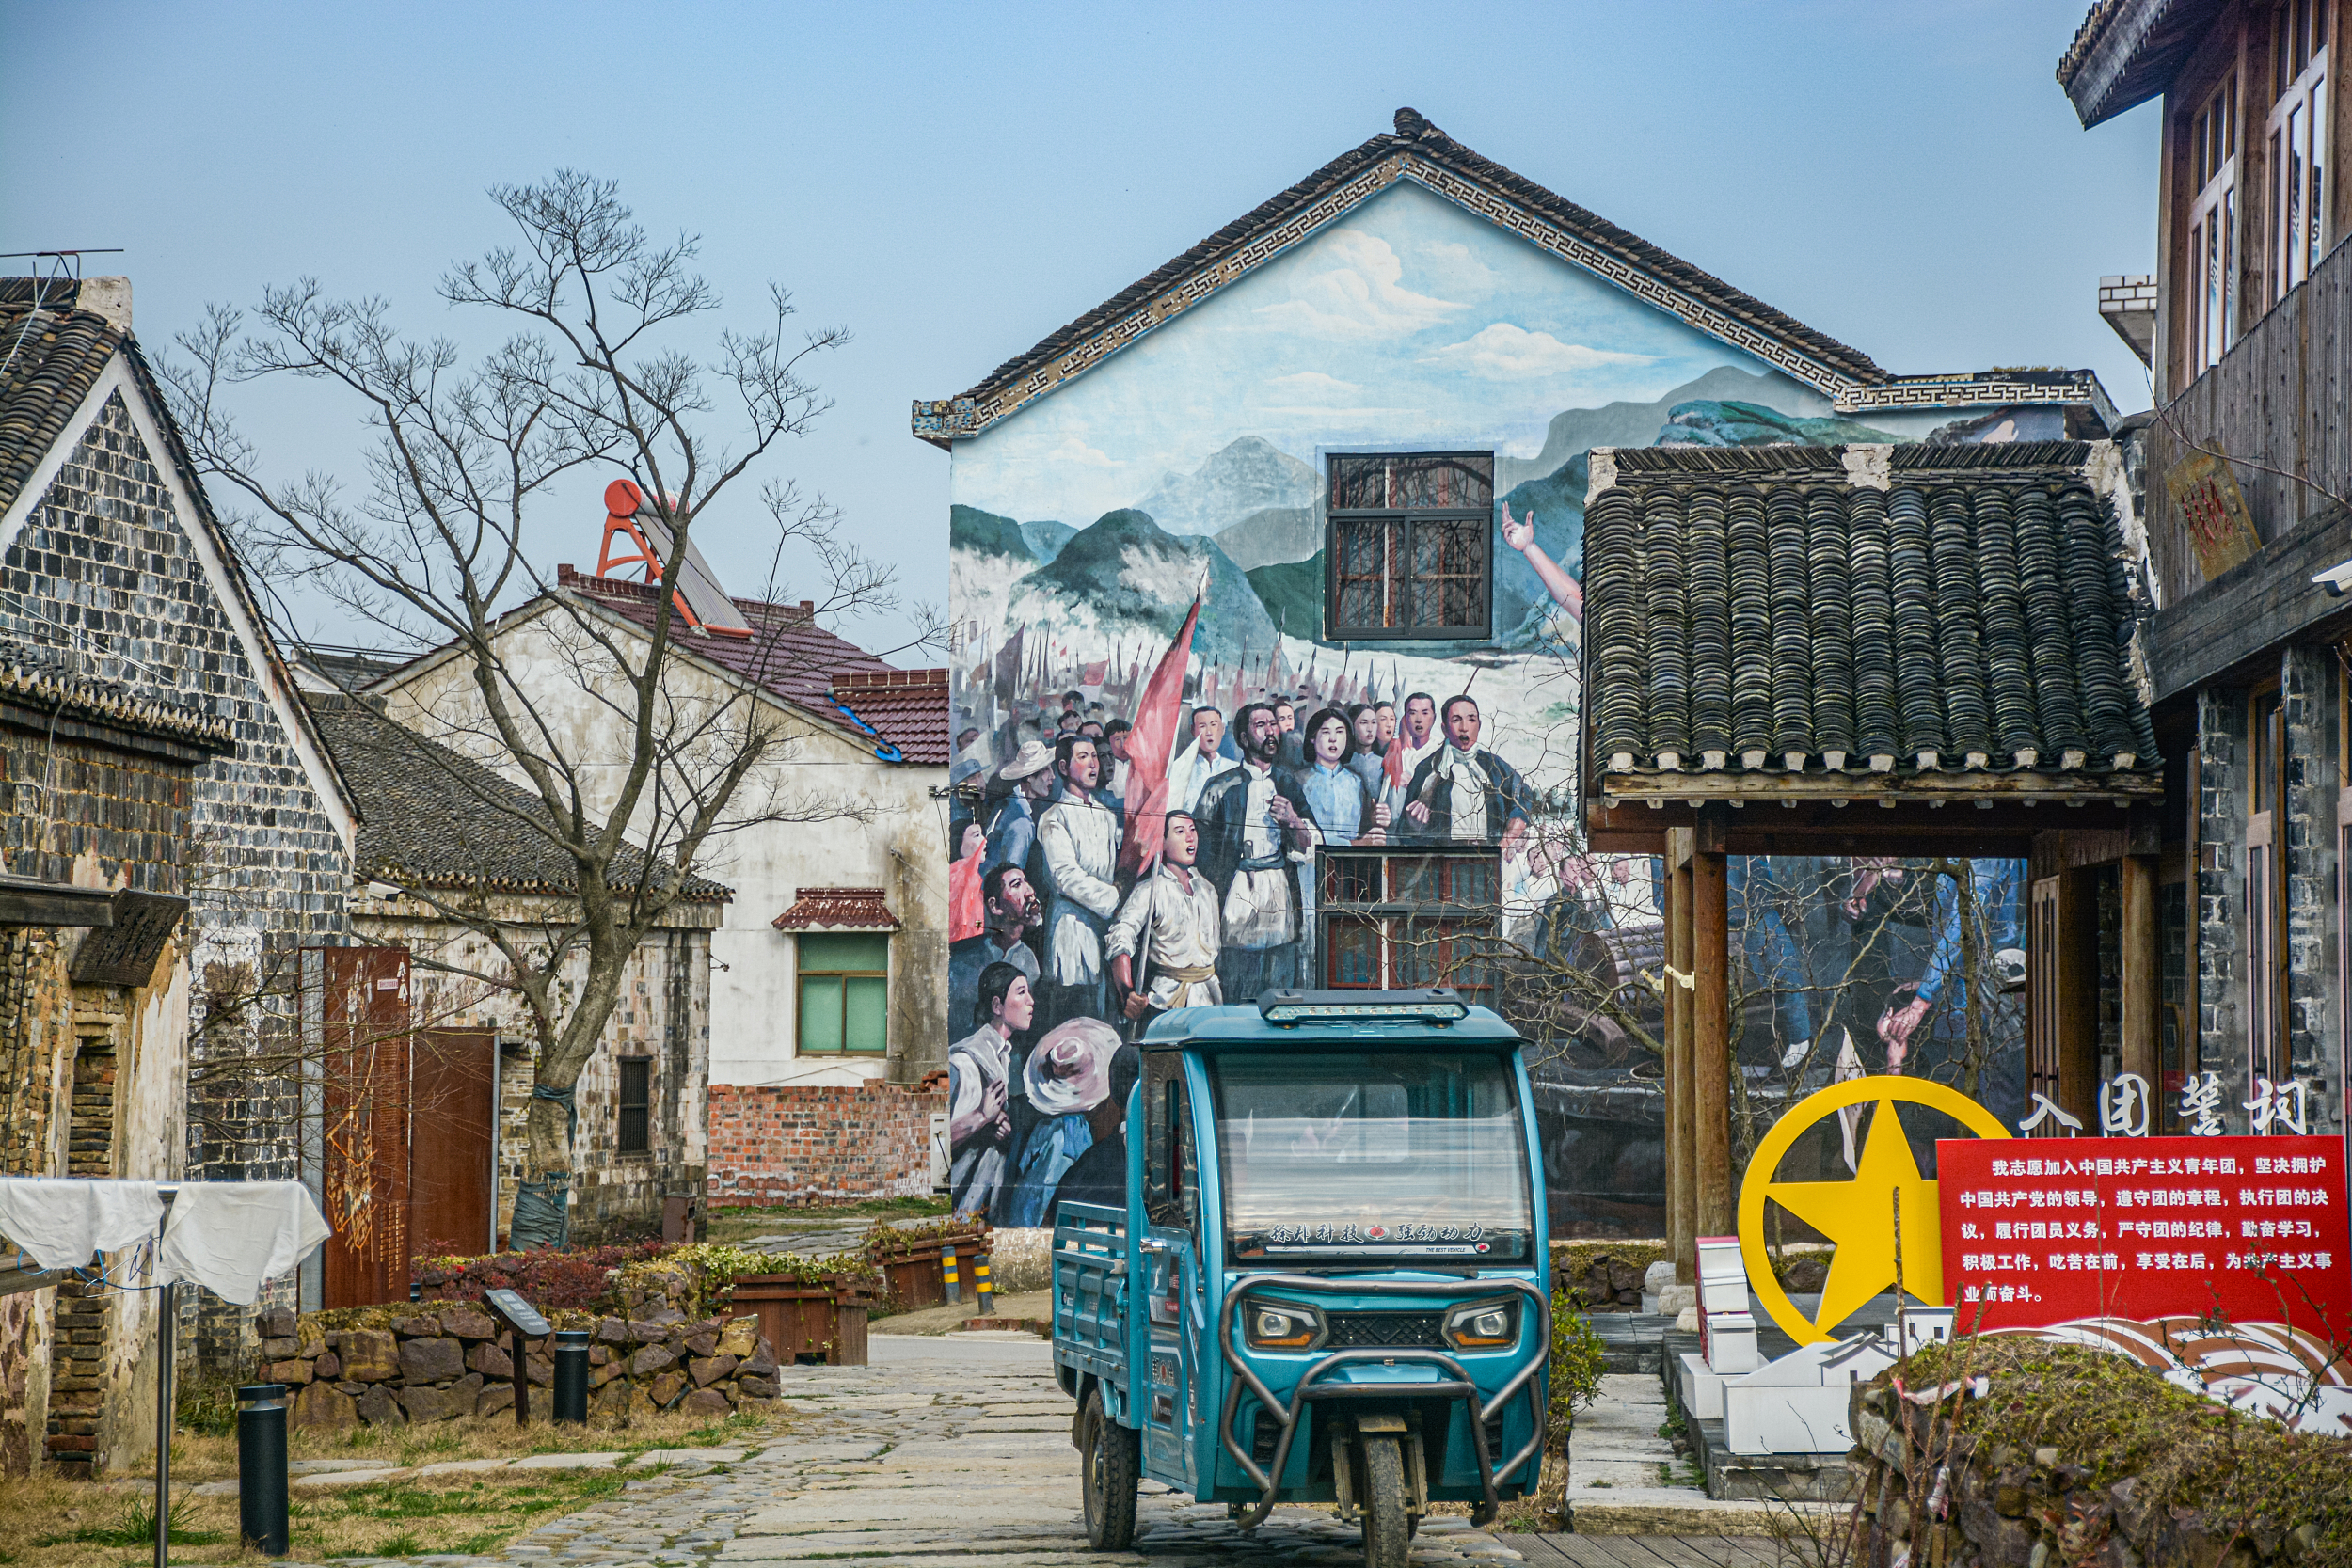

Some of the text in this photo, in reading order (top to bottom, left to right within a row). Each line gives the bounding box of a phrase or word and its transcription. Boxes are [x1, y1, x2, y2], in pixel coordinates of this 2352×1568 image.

[2019, 1073, 2307, 1137] 入团誓词
[1993, 1157, 2326, 1176] 我志愿加入中国共产主义青年团，坚决拥护
[1961, 1189, 2328, 1208] 中国共产党的领导，遵守团的章程，执行团的决
[1394, 1222, 1484, 1243] 强劲动力
